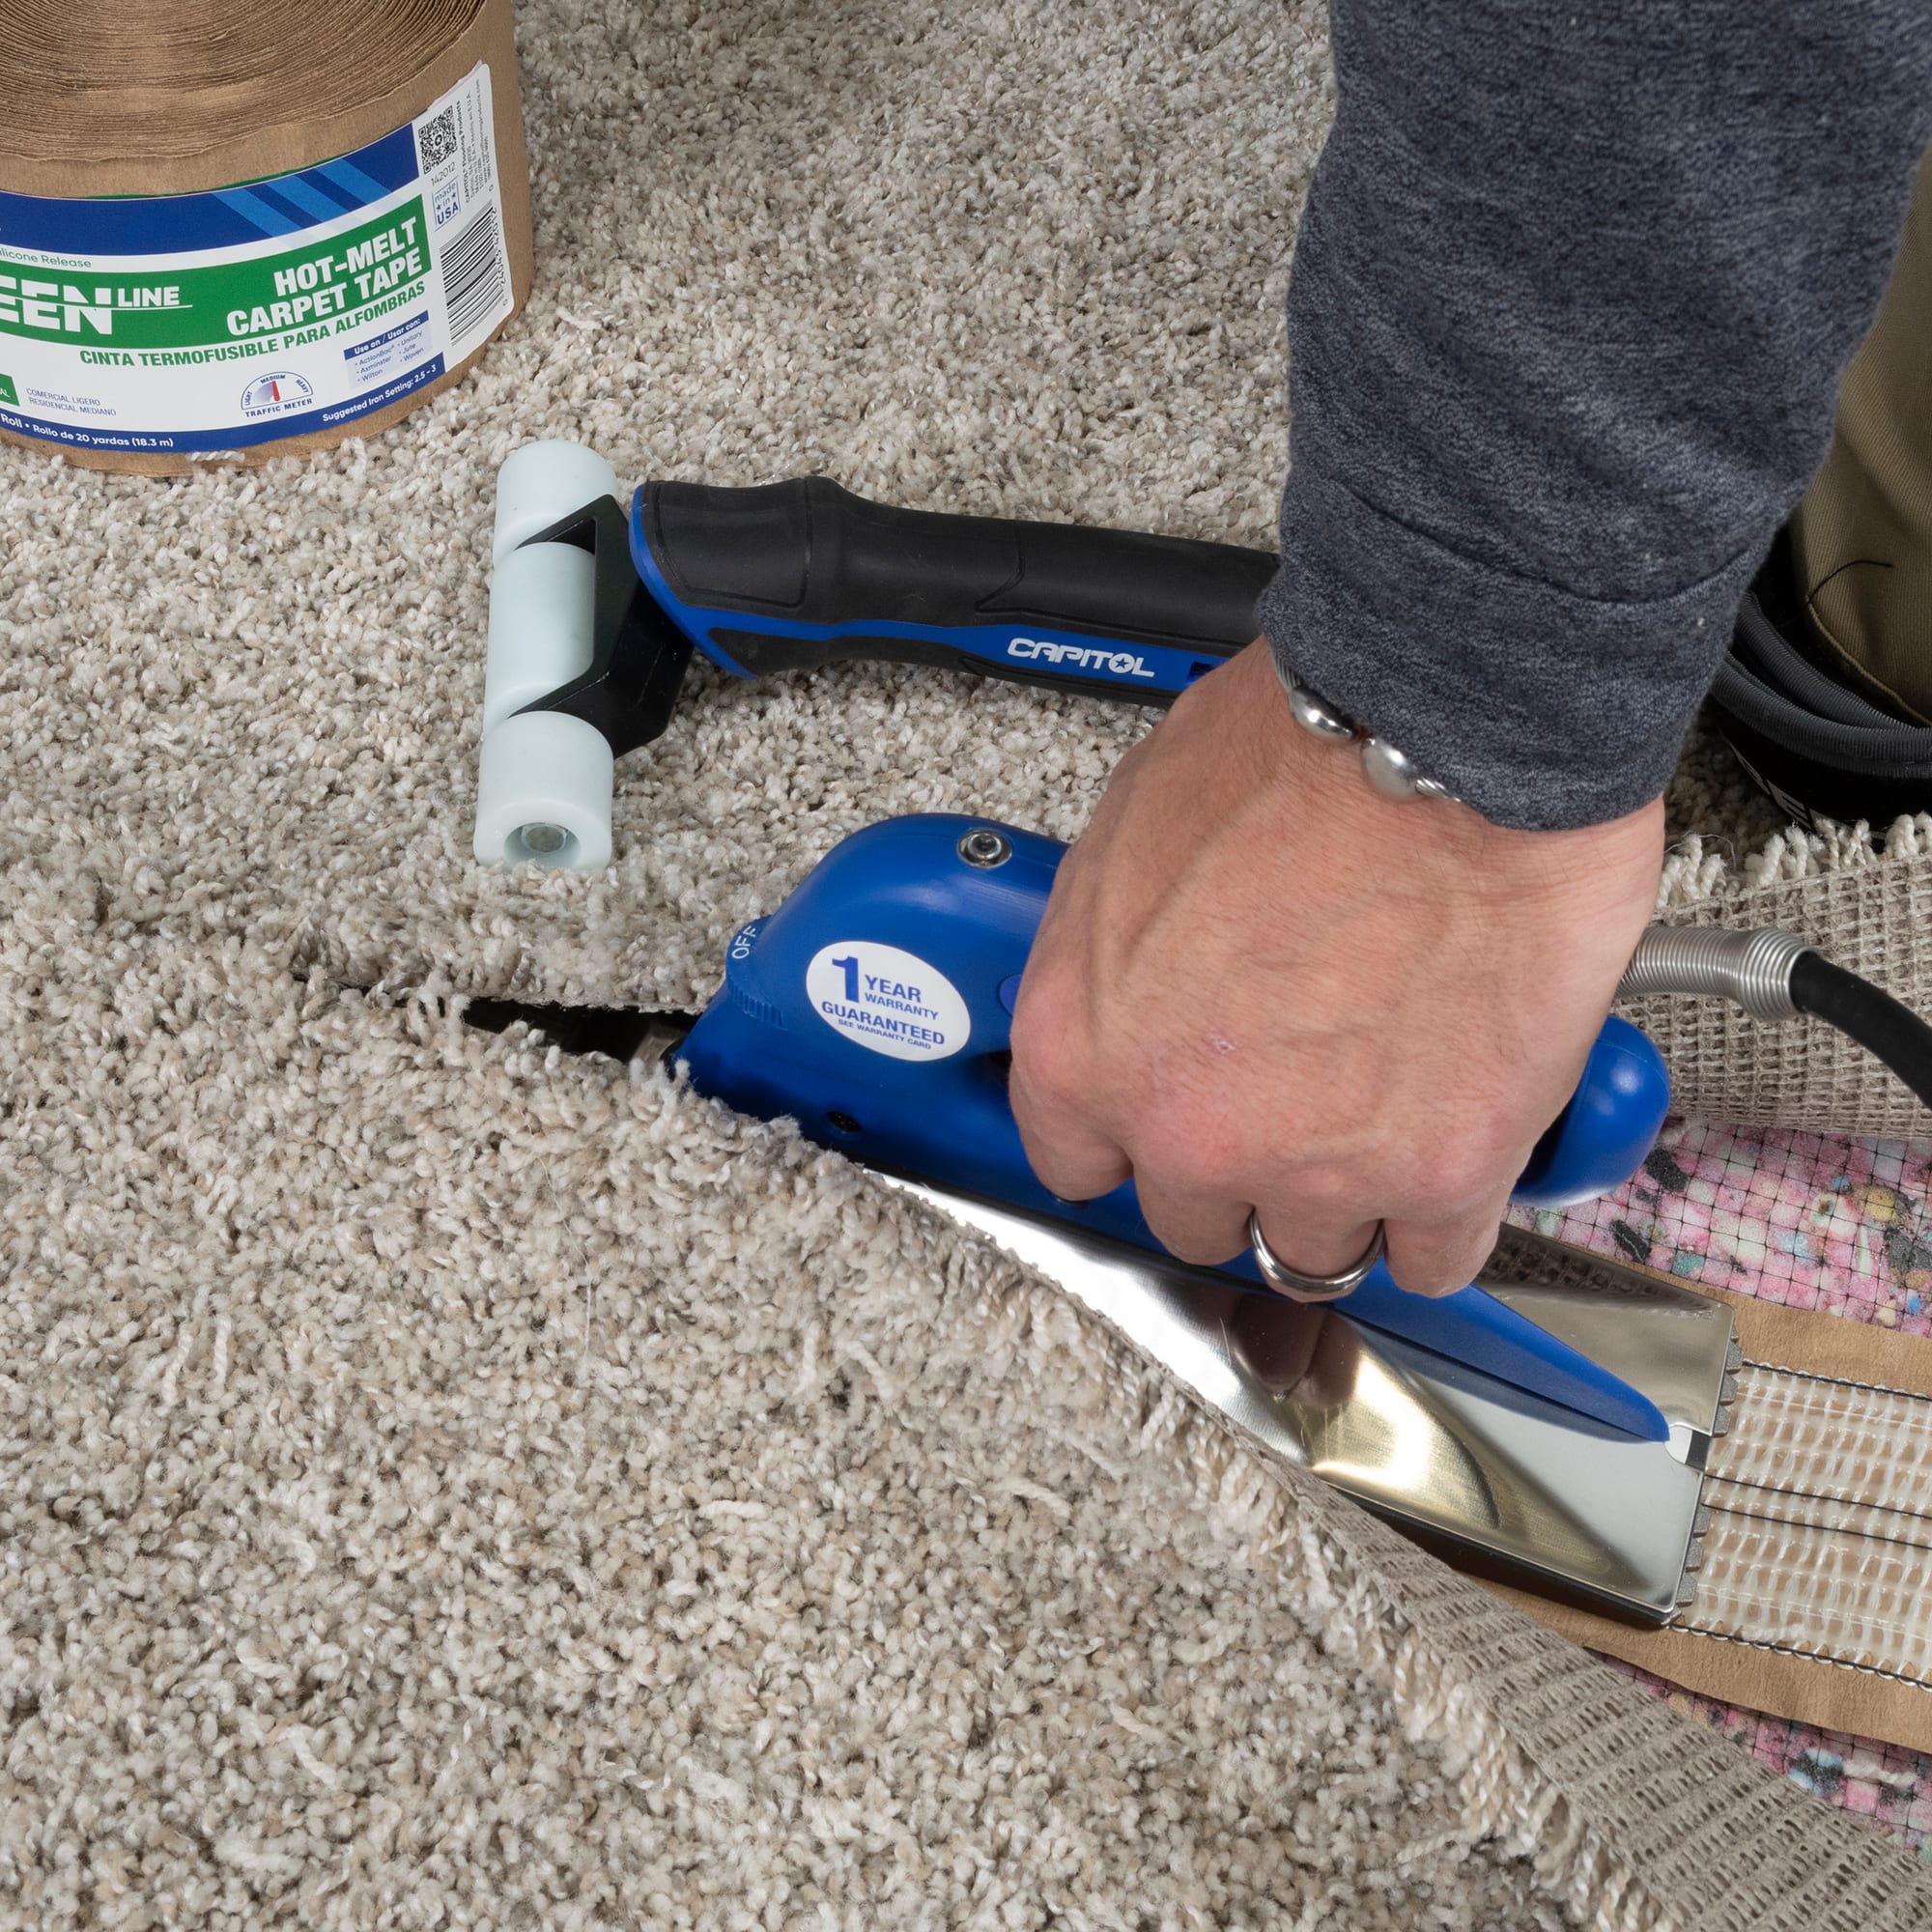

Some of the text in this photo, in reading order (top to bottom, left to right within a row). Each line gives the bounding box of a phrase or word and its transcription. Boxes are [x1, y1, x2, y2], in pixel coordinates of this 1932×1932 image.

[431, 162, 455, 185] 142012
[434, 183, 456, 203] made
[443, 195, 450, 207] in
[437, 202, 459, 225] USA
[41, 254, 92, 268] Release
[274, 216, 416, 297] HOT-MELT
[118, 286, 180, 307] LINE
[226, 246, 422, 336] CARPET TAPE
[79, 281, 425, 366] CINTA TERMOFUSIBLE PARA ALFOMBRAS
[354, 345, 369, 355] Use
[370, 339, 381, 348] on
[387, 327, 405, 340] Usar
[406, 318, 420, 330] con:
[401, 330, 422, 346] Unitary
[403, 343, 416, 354] Jute
[403, 348, 424, 361] Woven
[360, 355, 391, 374] Axminster
[361, 369, 384, 382] Wilton
[260, 374, 286, 384] MEDIUM
[296, 379, 309, 393] HEAVY
[26, 387, 100, 406] COMERCIAL LIGERO
[323, 400, 368, 422] Suggested
[369, 394, 384, 406] Iron
[385, 379, 414, 399] Setting:
[414, 370, 426, 382] 2.5
[431, 364, 437, 373] 3
[29, 397, 117, 416] RESIDENCIAL MEDIANO
[245, 398, 313, 417] TRAFFIC METER
[0, 413, 174, 447] Roll Rollo de 20 yardas (18.3 m)
[1008, 638, 1154, 678] CAPITOL
[731, 925, 756, 959] OFF
[832, 955, 922, 1003] 1 YEAR
[865, 992, 938, 1020] WARRANTY
[821, 1001, 945, 1045] GUARANTEED
[838, 1018, 931, 1050] SEE WARRANTY CARD
